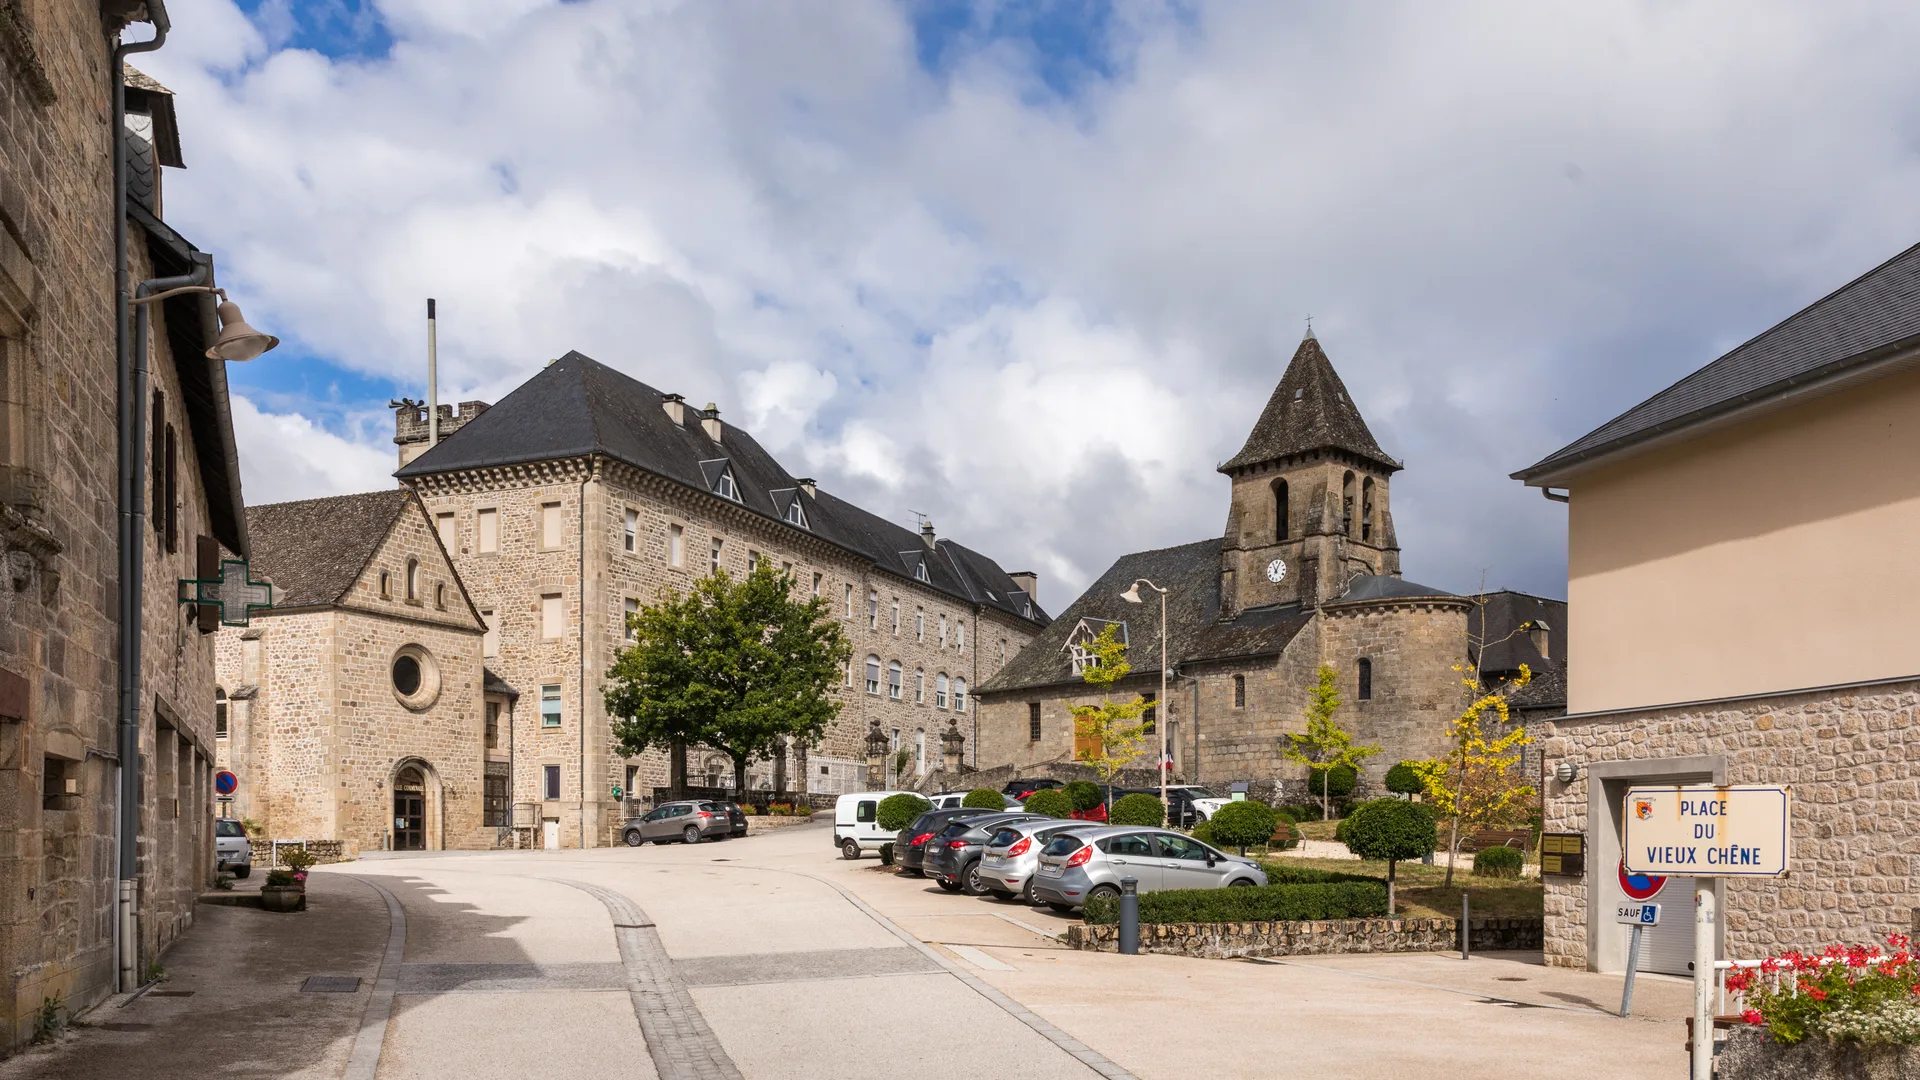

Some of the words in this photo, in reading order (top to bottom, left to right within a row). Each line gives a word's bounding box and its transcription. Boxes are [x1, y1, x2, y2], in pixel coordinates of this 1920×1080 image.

[1680, 800, 1728, 816] PLACE
[1694, 823, 1715, 839] DU
[1646, 846, 1697, 864] VIEUX
[1707, 844, 1761, 865] CHÊNE
[1617, 907, 1641, 918] SAUF
